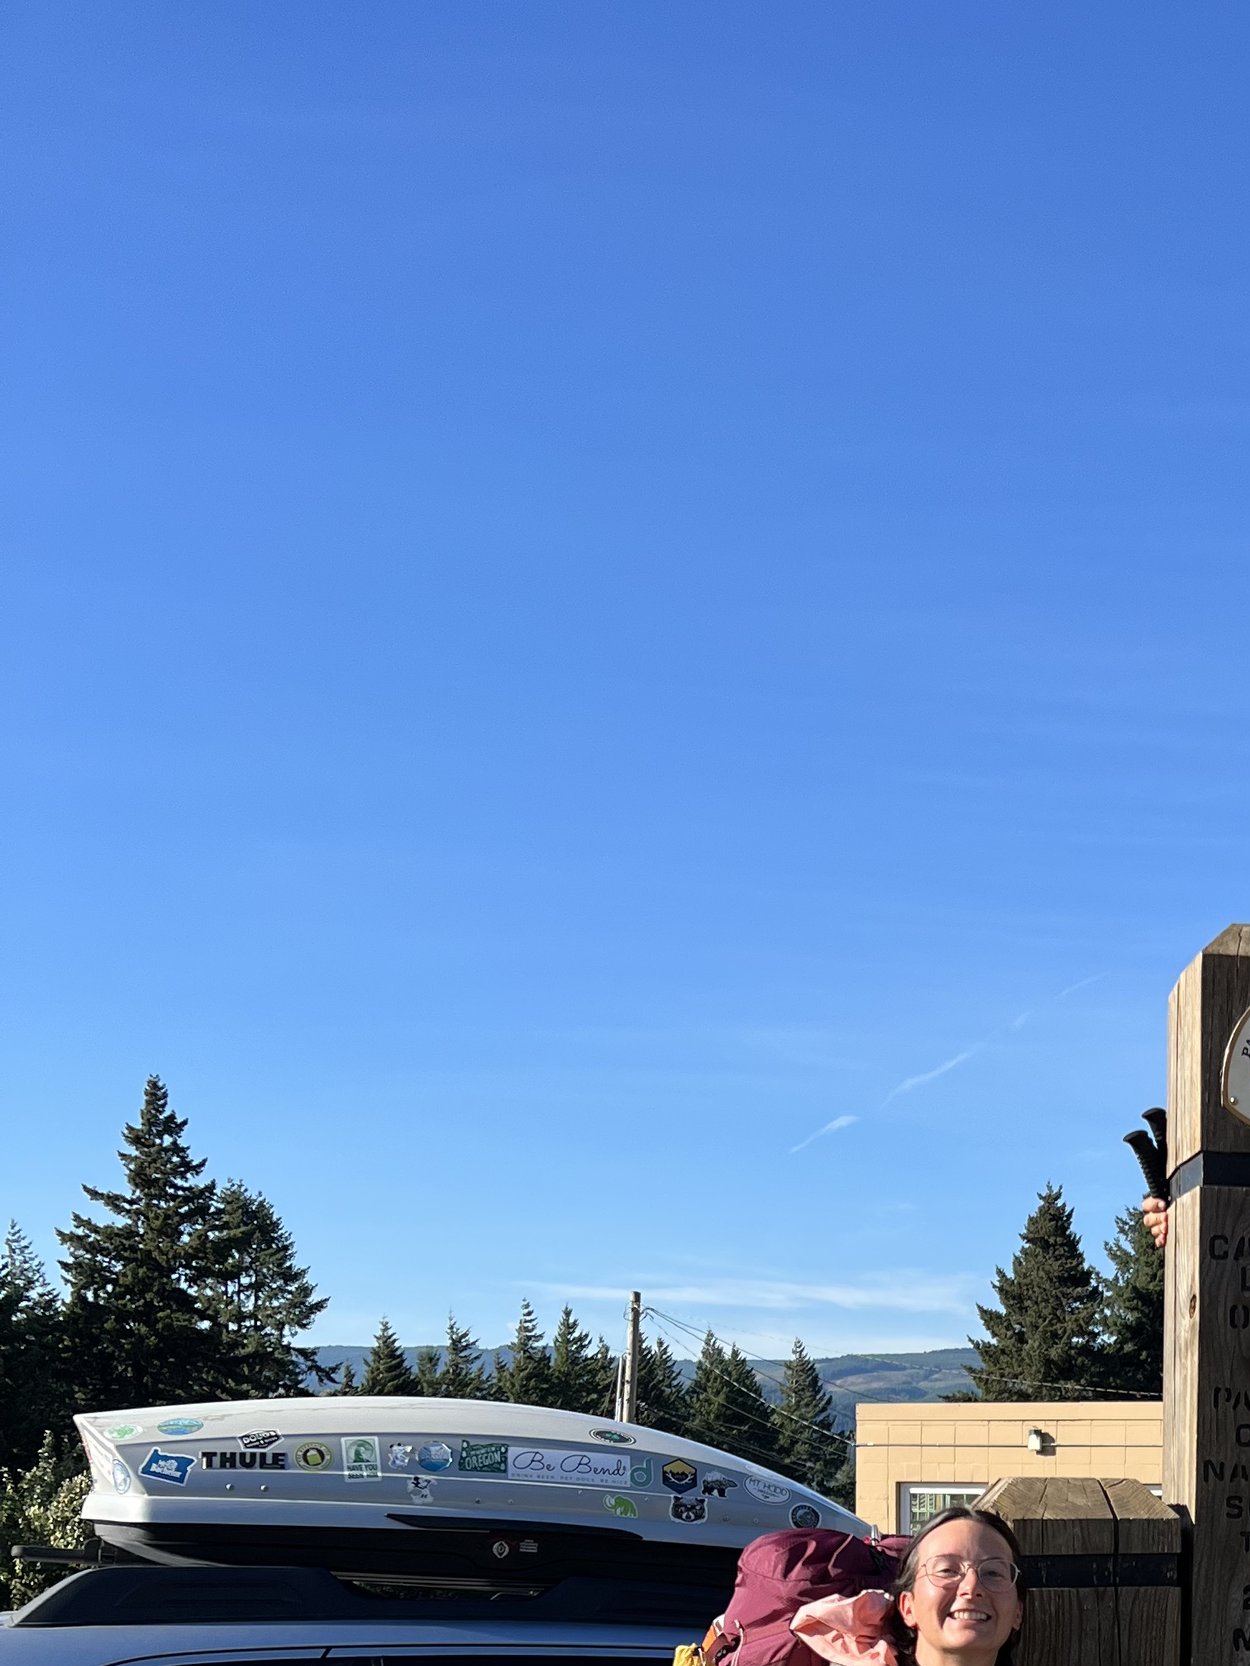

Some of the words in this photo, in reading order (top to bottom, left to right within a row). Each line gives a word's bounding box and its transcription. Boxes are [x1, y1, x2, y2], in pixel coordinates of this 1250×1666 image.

[202, 1451, 286, 1470] THULE
[347, 1464, 363, 1472] HAVE
[364, 1463, 378, 1471] YOU
[465, 1450, 501, 1470] OREGON
[512, 1451, 556, 1472] Be
[560, 1454, 627, 1478] Bend
